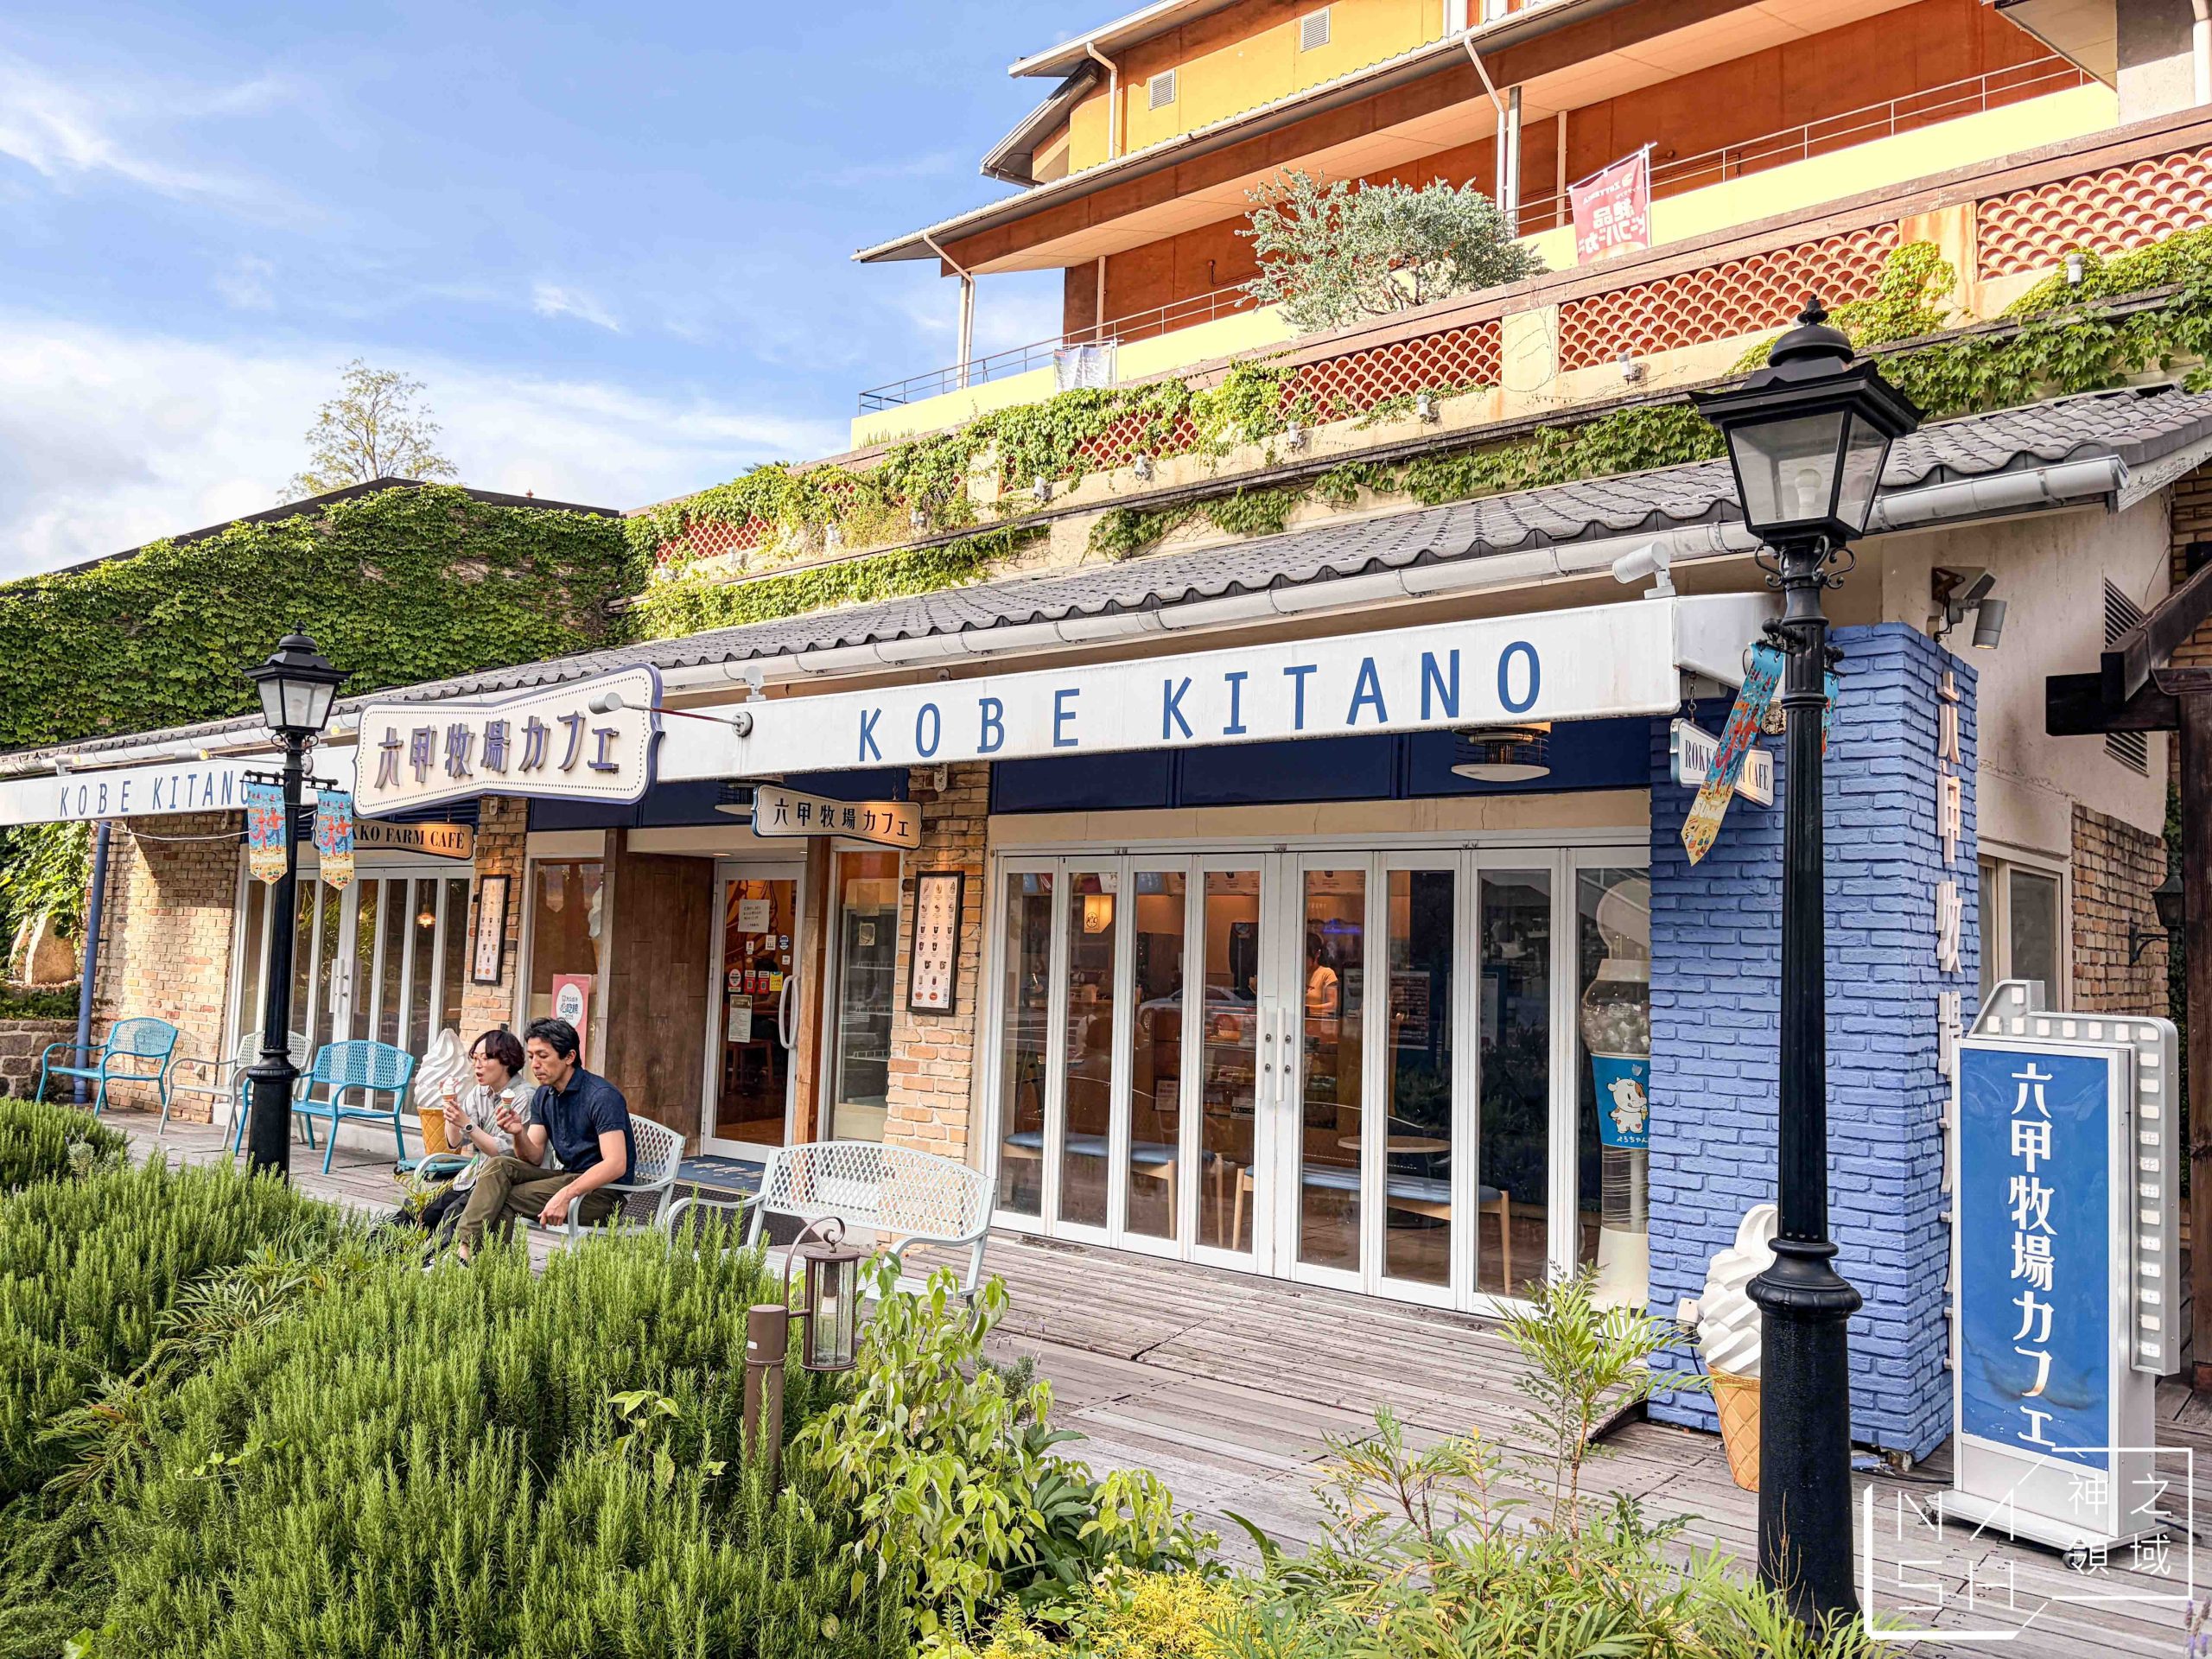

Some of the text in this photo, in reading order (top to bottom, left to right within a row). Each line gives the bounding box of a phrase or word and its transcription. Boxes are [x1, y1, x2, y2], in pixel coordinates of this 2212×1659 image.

[859, 640, 1541, 762] KOBE KITANO
[374, 709, 620, 789] 六甲牧場カフェ
[1685, 739, 1716, 772] ROKK
[60, 779, 131, 817] KOBE
[773, 798, 909, 837] 六甲牧場カフェ
[386, 827, 425, 846] FARM
[2007, 1062, 2058, 1448] 六甲牧場カフェ
